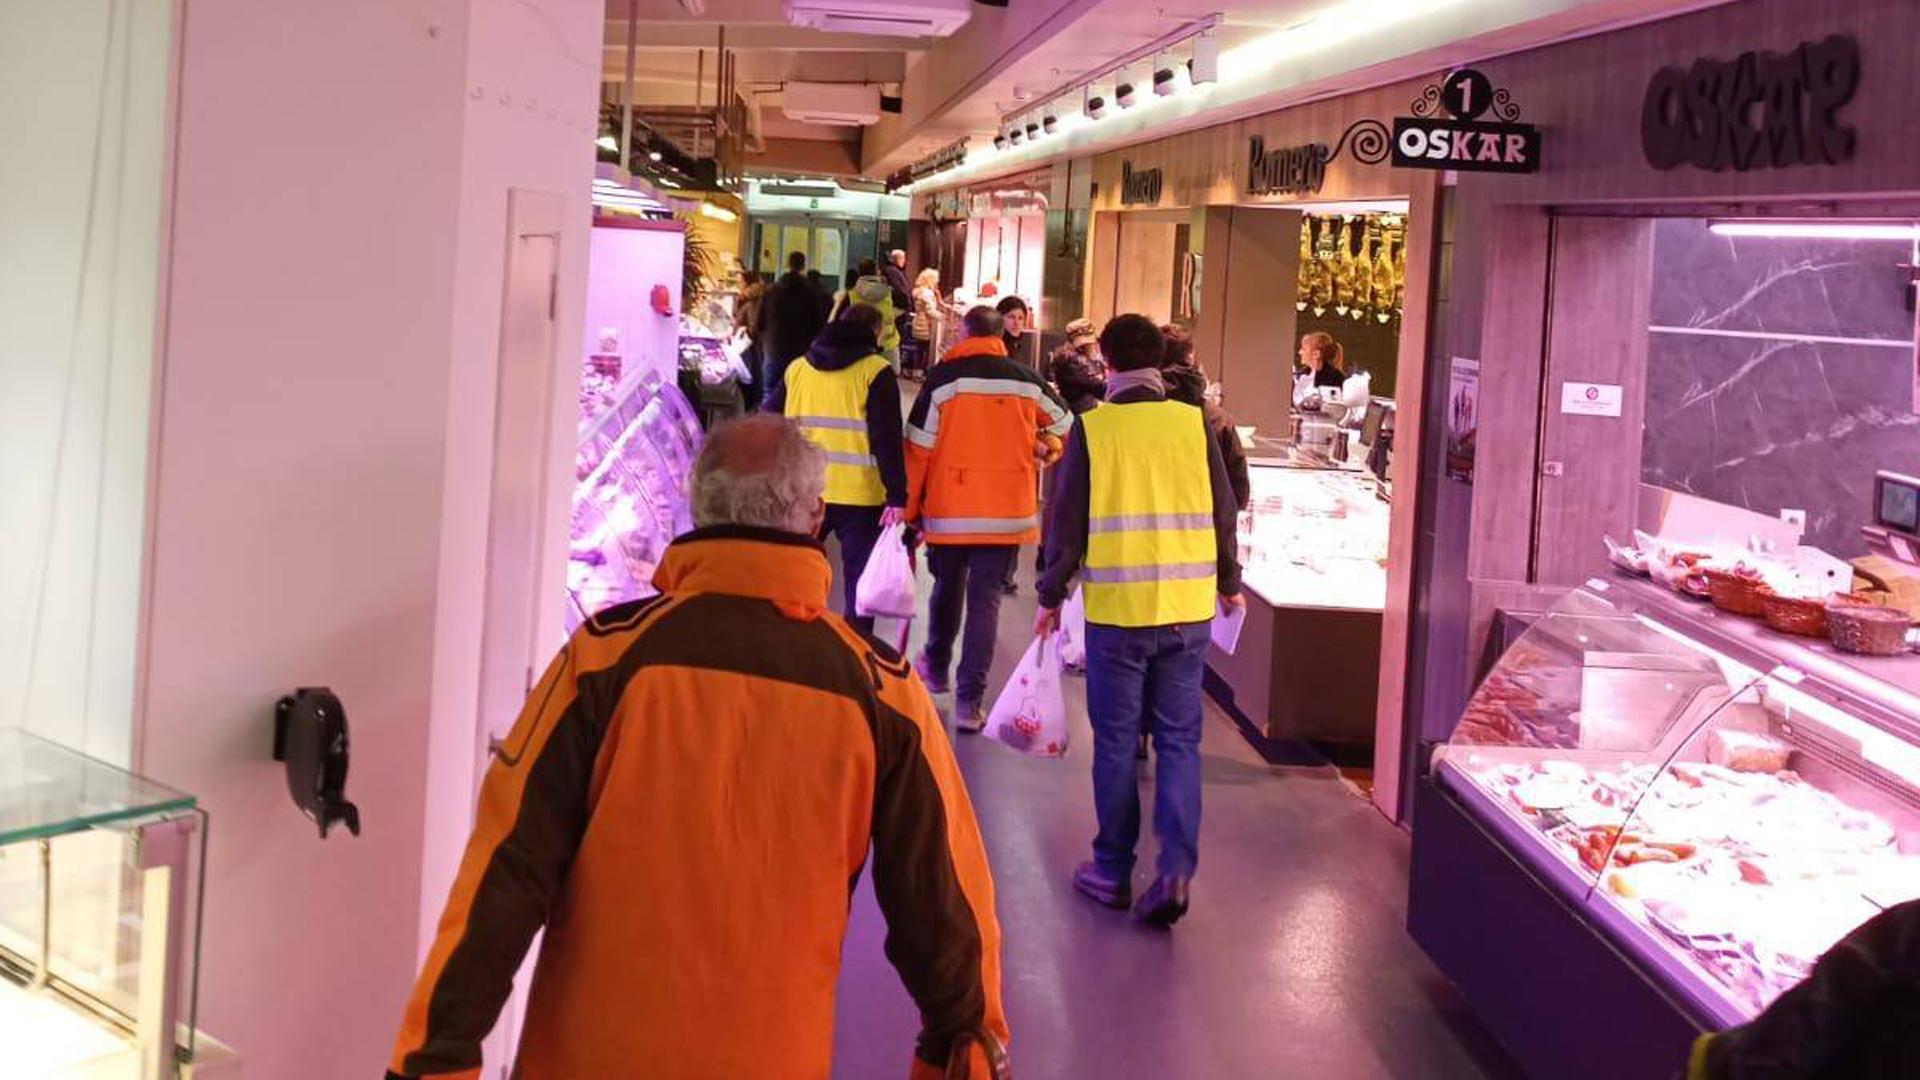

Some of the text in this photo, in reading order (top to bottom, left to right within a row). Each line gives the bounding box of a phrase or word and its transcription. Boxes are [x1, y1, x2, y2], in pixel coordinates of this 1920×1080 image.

[1456, 77, 1473, 114] 1
[1642, 34, 1861, 173] OSKAR
[1247, 134, 1329, 196] Romero
[1398, 127, 1527, 164] OSKAR
